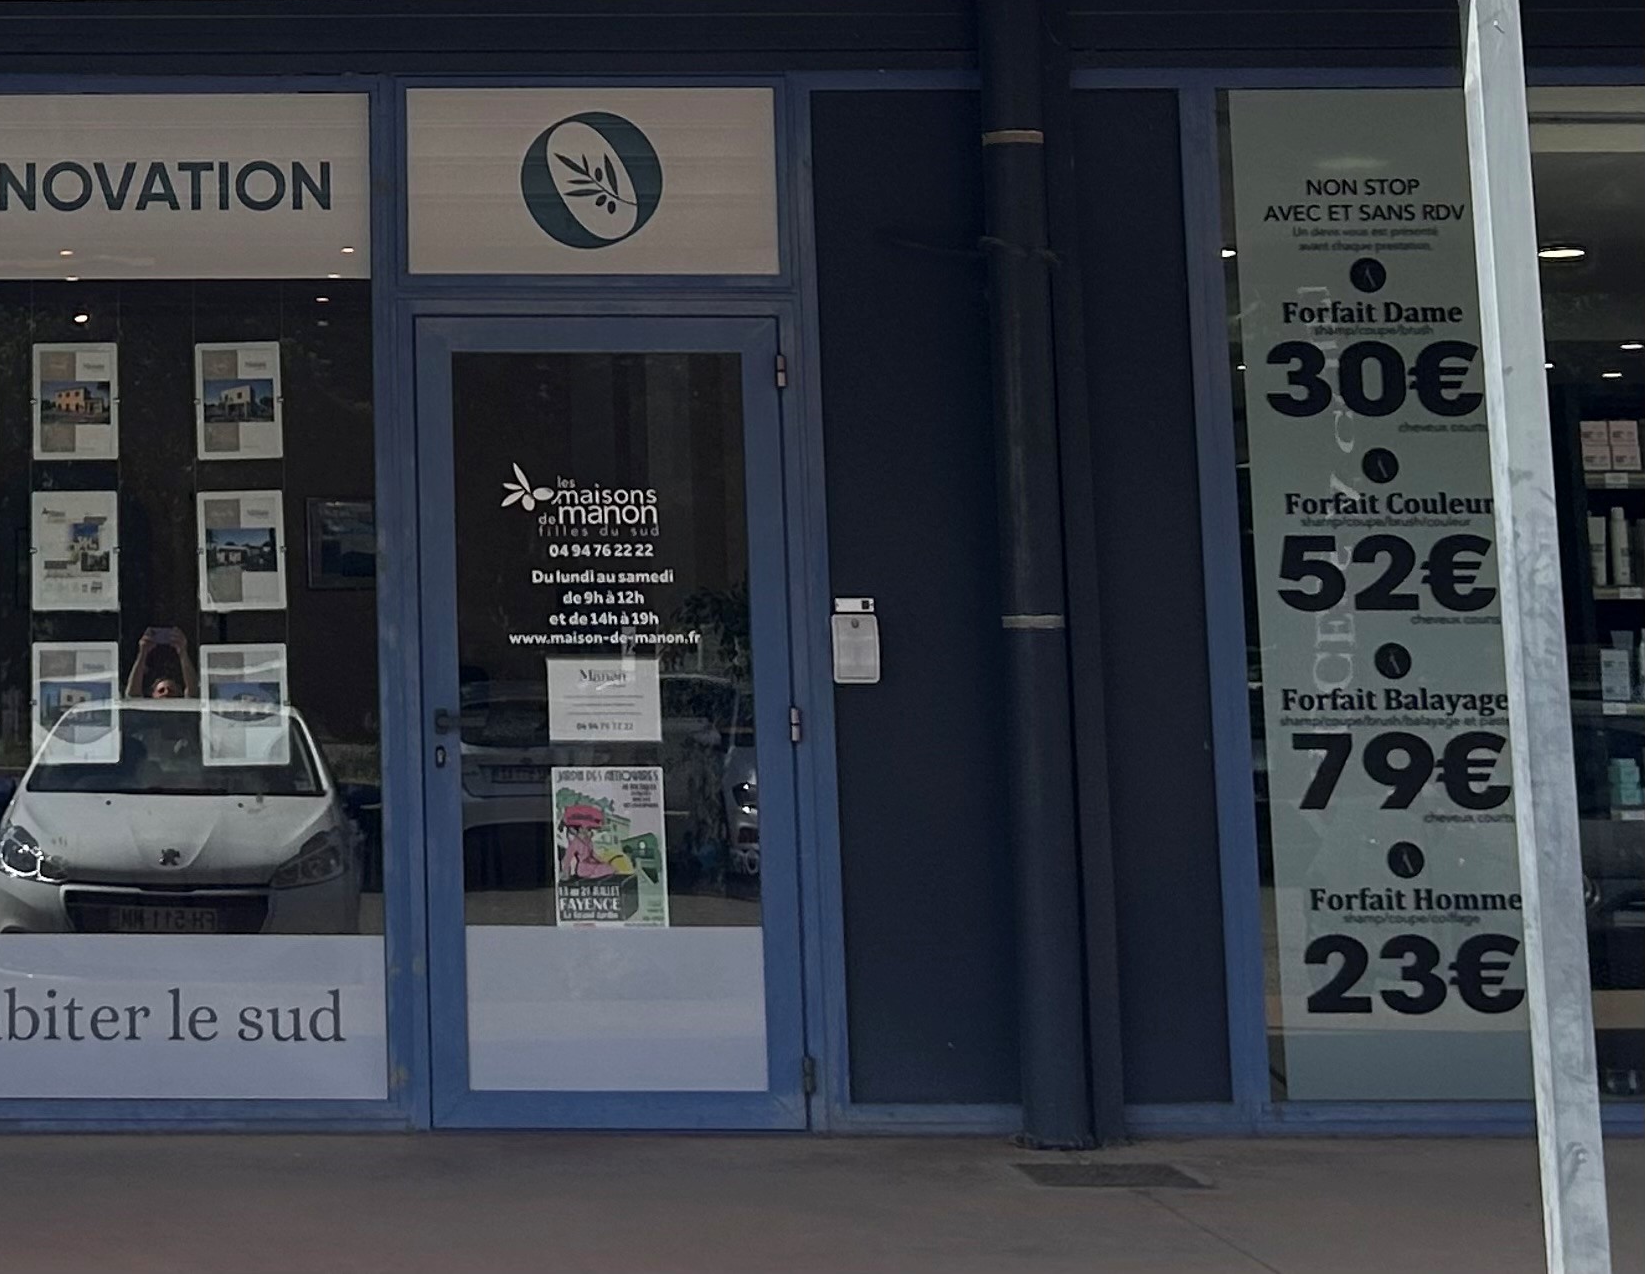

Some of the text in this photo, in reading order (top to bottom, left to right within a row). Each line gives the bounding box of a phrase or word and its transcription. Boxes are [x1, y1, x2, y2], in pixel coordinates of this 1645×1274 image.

[1306, 179, 1420, 196] NON STOP
[1263, 204, 1465, 221] AVEC ET SANS RDV
[1282, 301, 1463, 324] Forfait Dame
[1266, 340, 1484, 418] 30€
[557, 475, 575, 488] les
[556, 483, 657, 504] maisons
[1284, 493, 1379, 515] Forfait
[538, 505, 658, 525] de manon
[538, 525, 659, 537] filles du sud
[549, 544, 654, 557] 04 94 76 22 22
[532, 569, 674, 583] Du lundi au samedi
[1277, 534, 1497, 612] 52€
[563, 590, 645, 604] de 9h à 12h
[549, 611, 659, 625] et de 14h à 19h
[509, 630, 701, 644] www.maison-de-manon.fr
[1282, 688, 1509, 717] Forfait Balayage
[1292, 731, 1511, 810] 79€
[560, 898, 621, 910] FAYENCE
[1310, 888, 1522, 912] Forfait Homme
[1303, 933, 1525, 1015] 23€
[168, 989, 219, 1042] le
[238, 989, 346, 1043] sud
